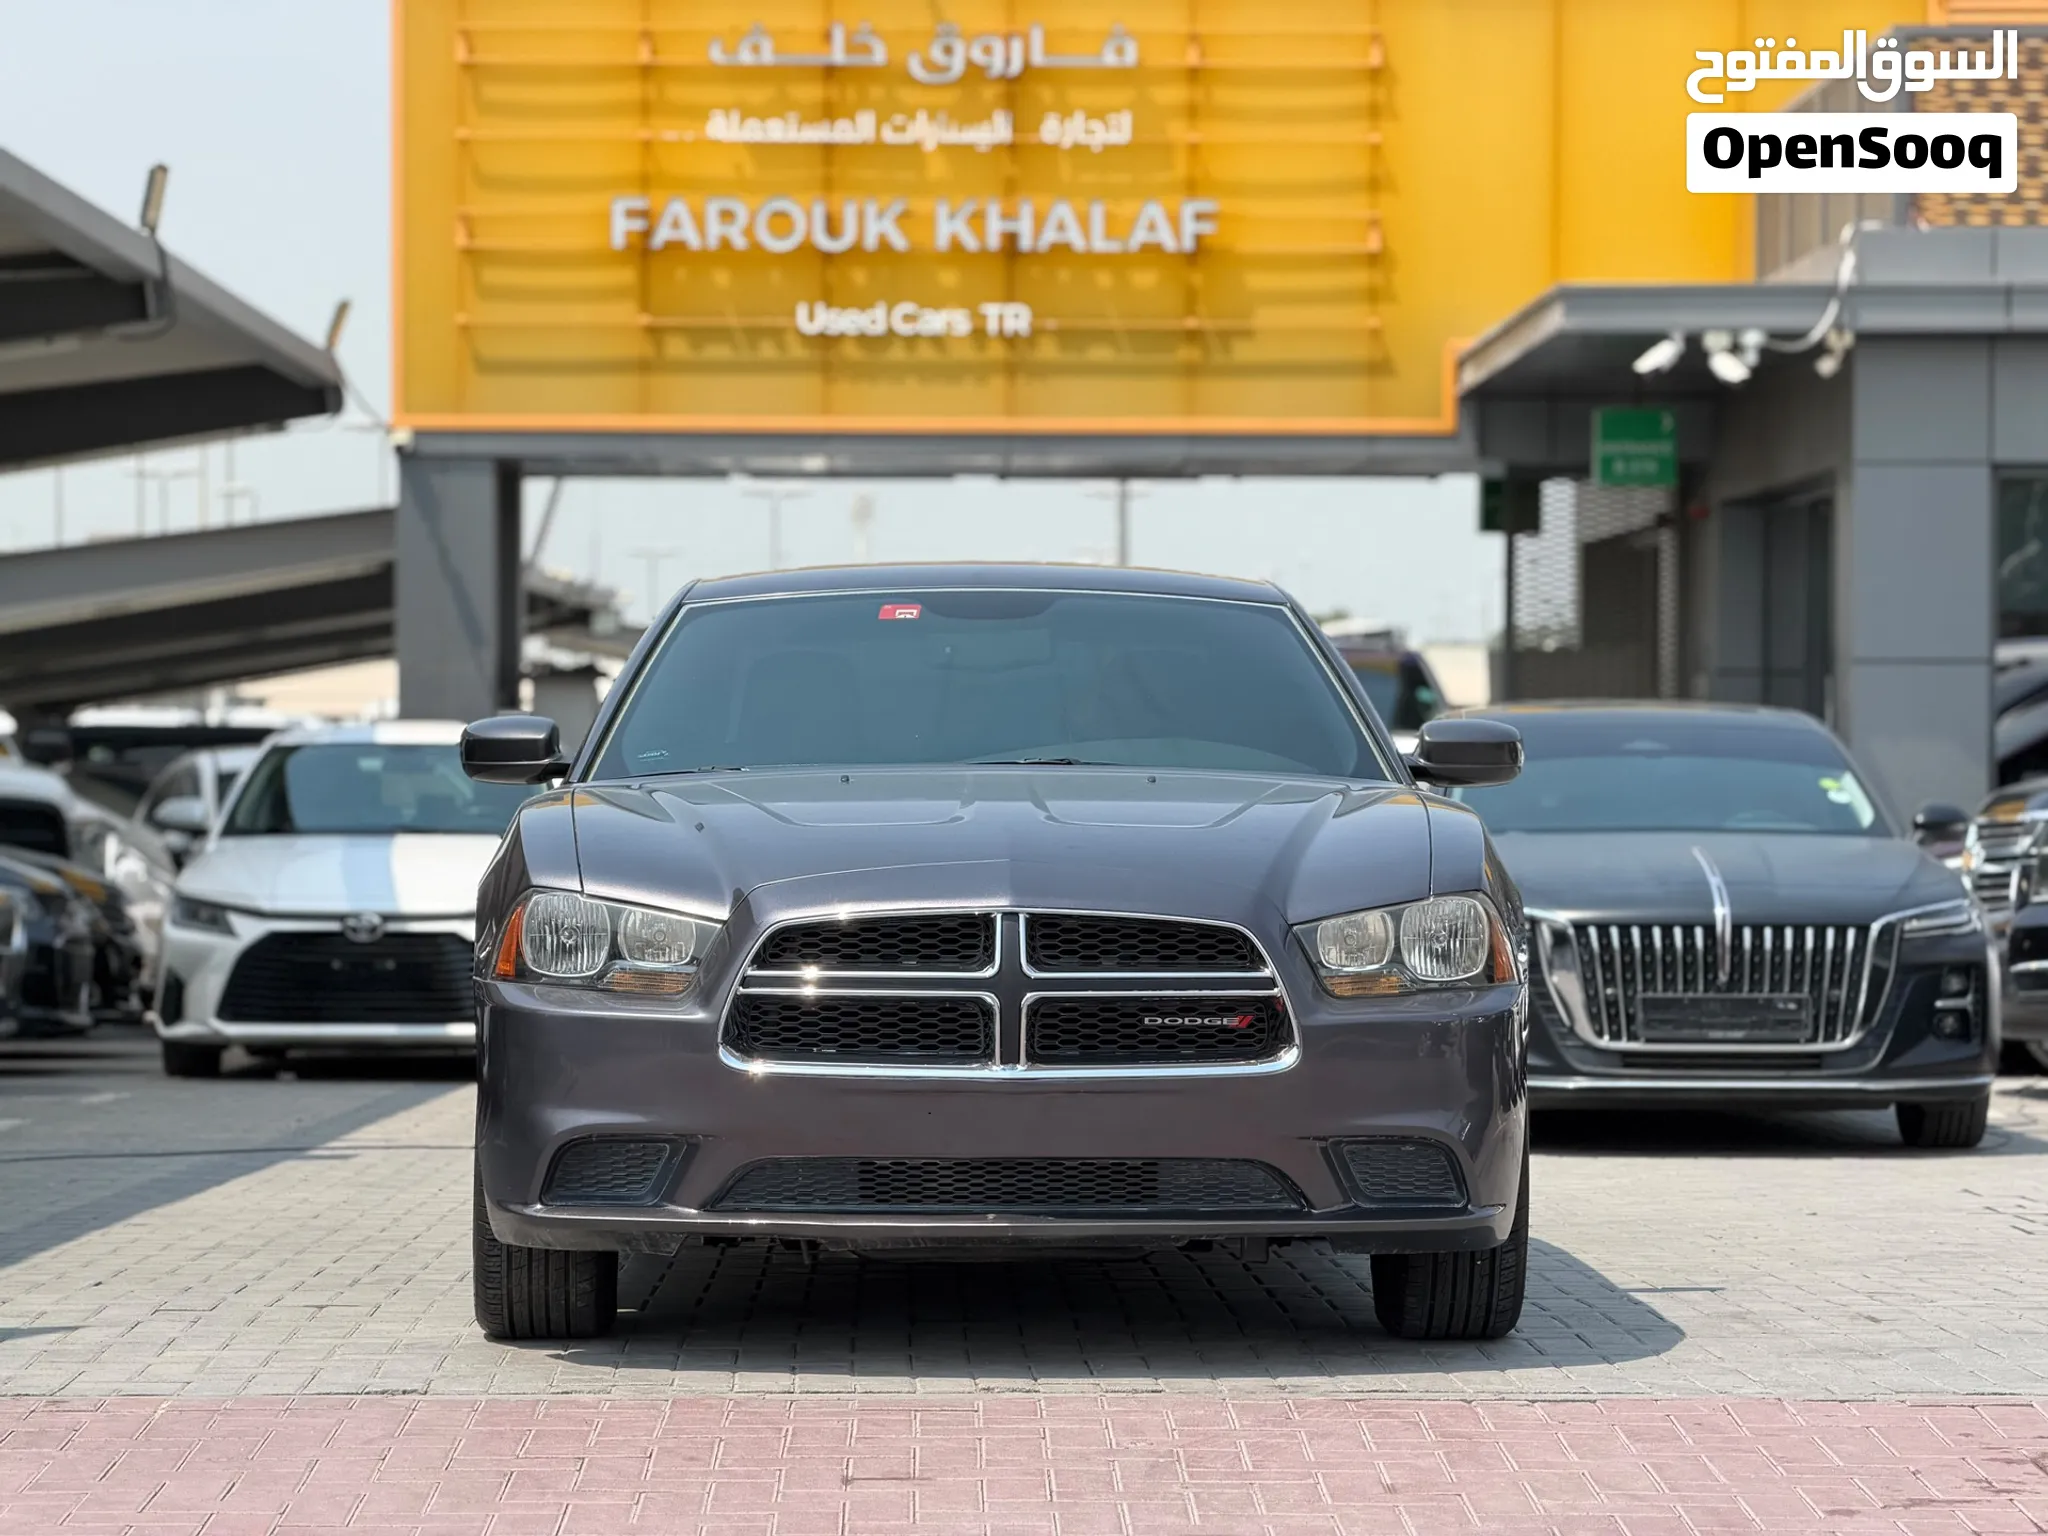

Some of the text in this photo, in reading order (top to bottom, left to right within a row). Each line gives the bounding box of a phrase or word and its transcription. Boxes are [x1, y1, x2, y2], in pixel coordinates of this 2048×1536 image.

[708, 20, 1139, 85] فاروق خلف
[609, 196, 1220, 253] FAROUK KHALAF
[795, 301, 1033, 337] Used Cars TR
[1144, 1016, 1240, 1026] DODGE
